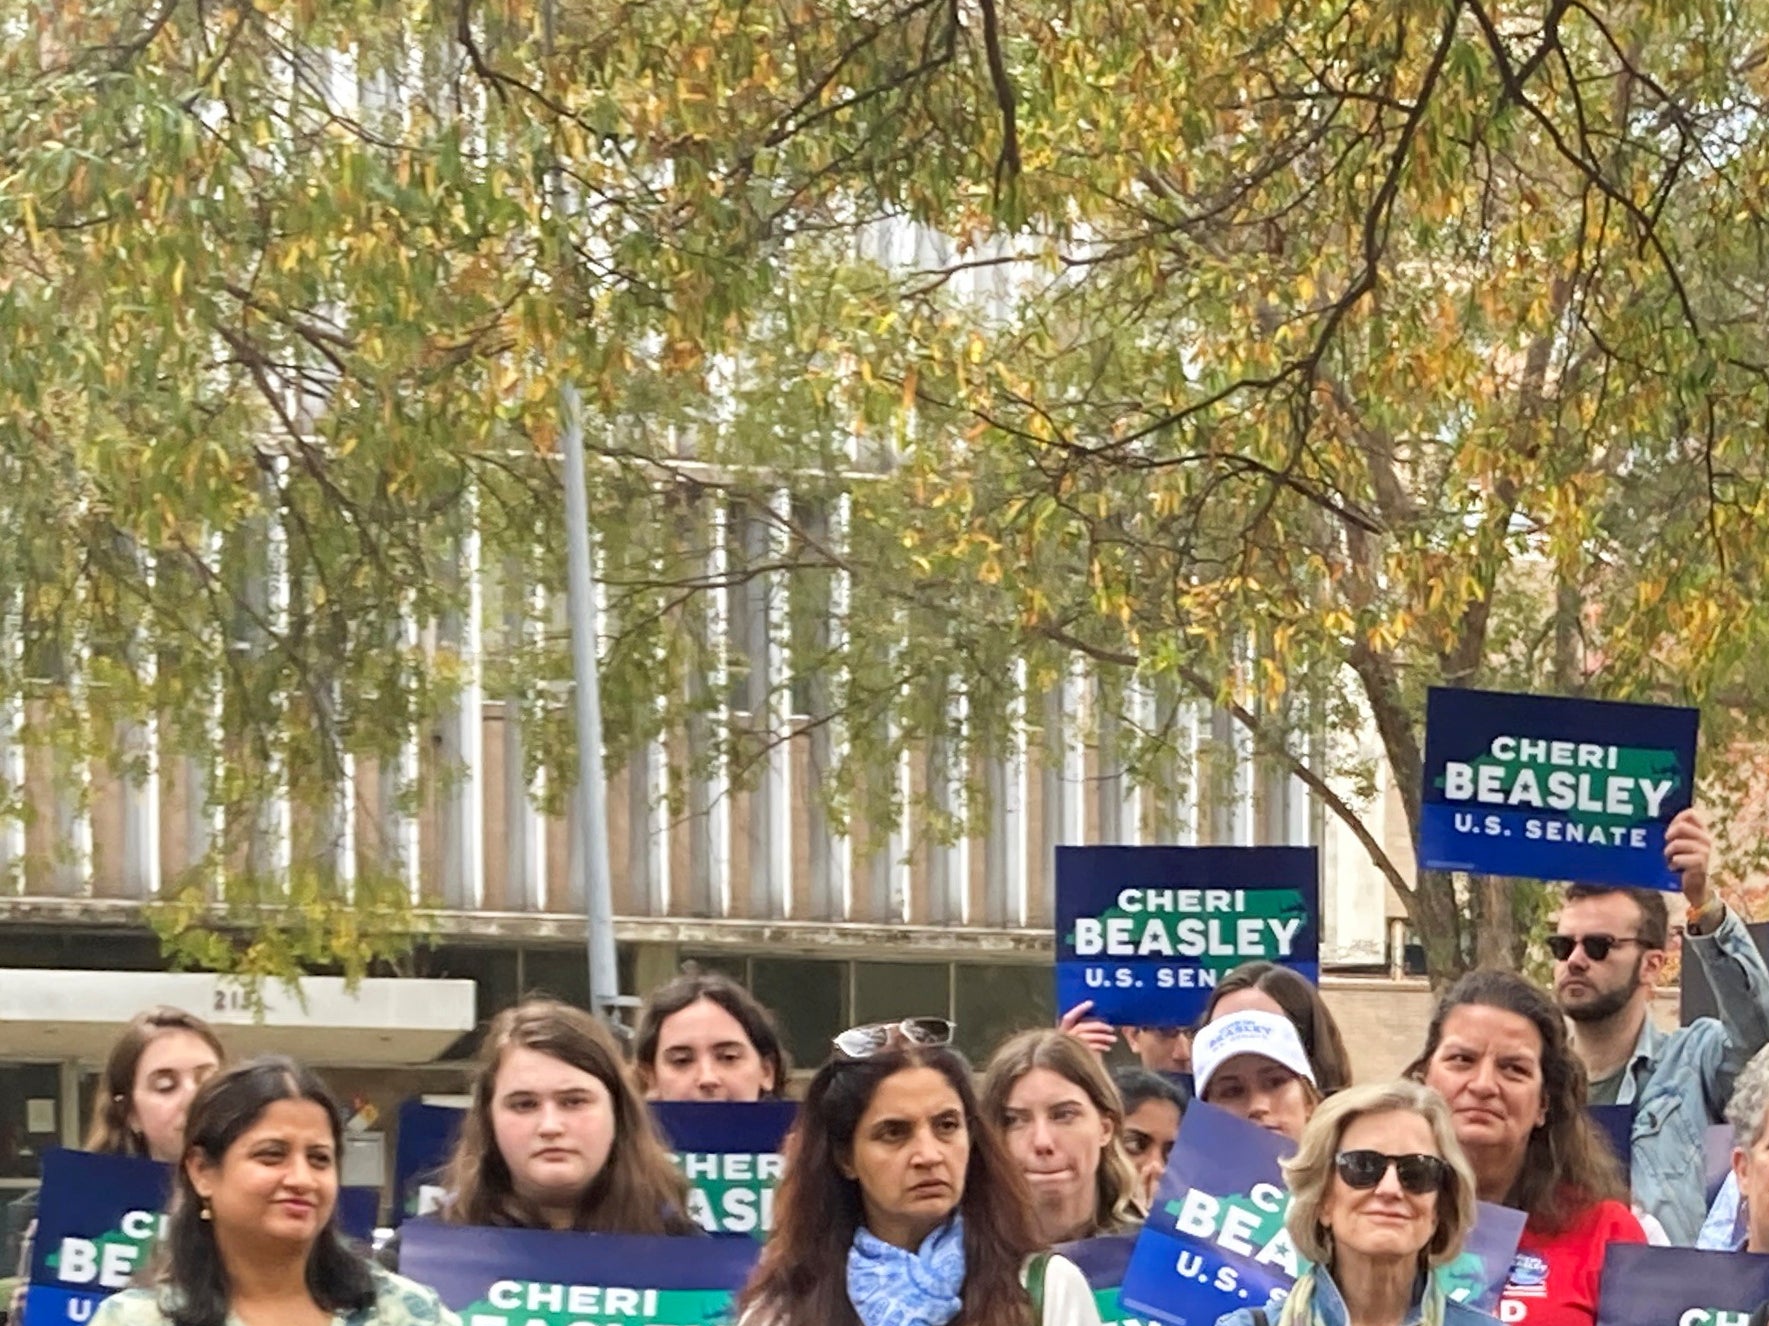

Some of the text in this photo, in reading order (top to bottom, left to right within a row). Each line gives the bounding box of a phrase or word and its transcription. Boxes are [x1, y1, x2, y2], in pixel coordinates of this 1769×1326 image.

[1490, 735, 1618, 770] CHERI
[1444, 761, 1673, 817] BEASLEY
[1454, 813, 1647, 848] U.S. SENATE
[1117, 888, 1245, 913] CHERI
[1075, 918, 1301, 957] BEASLEY
[1085, 968, 1234, 988] U.S. SEN
[664, 1152, 786, 1180] HER
[1176, 1251, 1248, 1298] U.S.
[488, 1280, 658, 1317] CHERI
